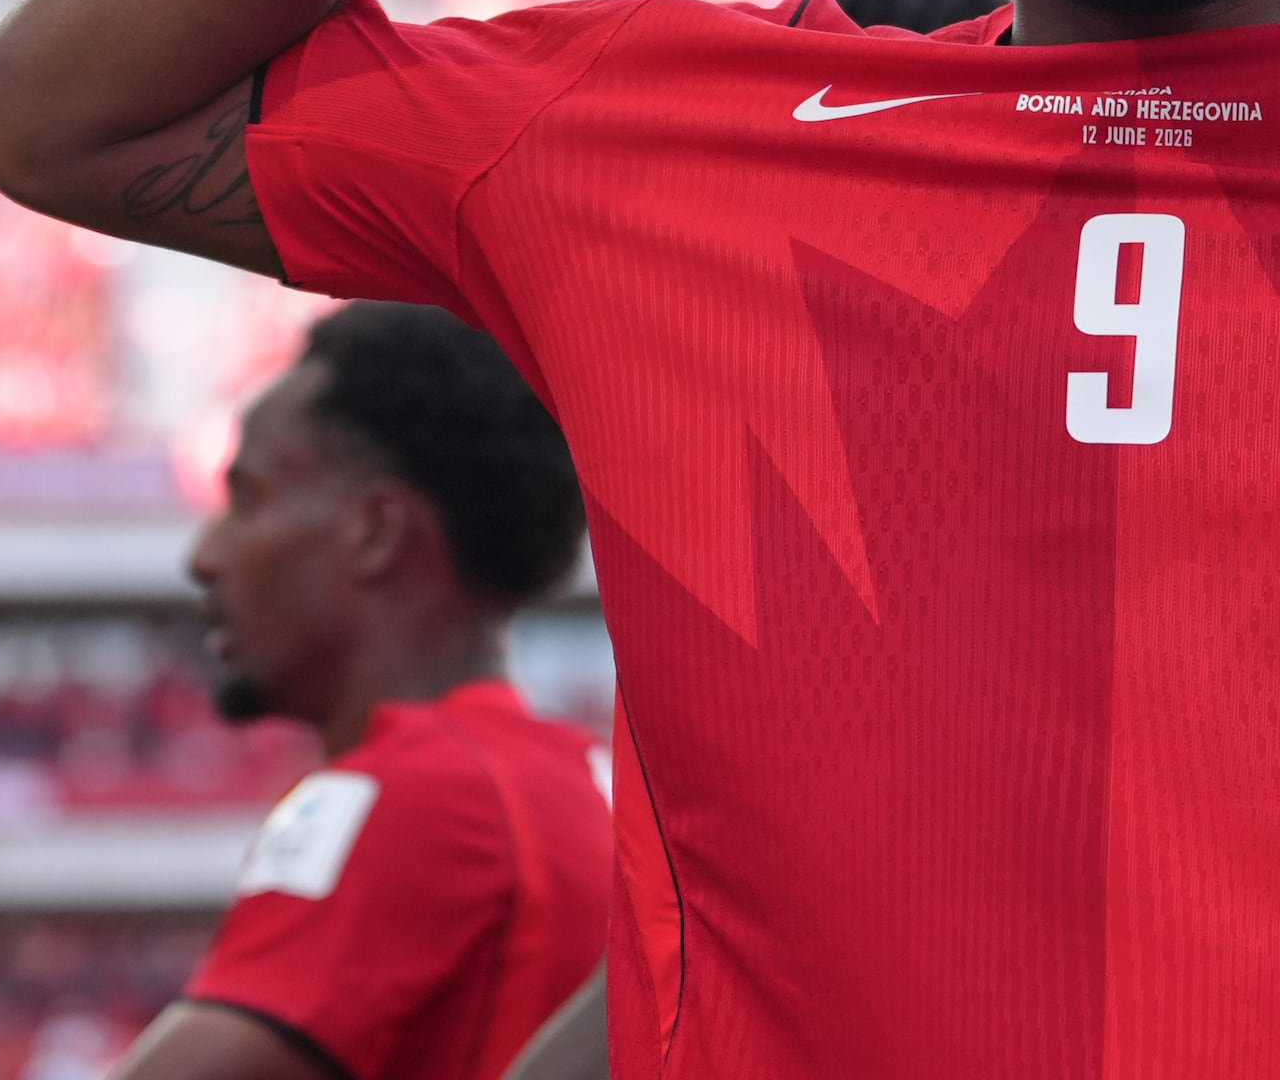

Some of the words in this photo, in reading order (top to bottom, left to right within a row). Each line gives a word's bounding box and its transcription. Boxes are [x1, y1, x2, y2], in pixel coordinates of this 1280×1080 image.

[1015, 93, 1084, 115] BOSNIA
[1091, 97, 1129, 118] AND
[1136, 100, 1263, 121] HERZEGOVINA
[1082, 125, 1097, 145] 12
[1105, 127, 1146, 146] JUNE
[1155, 128, 1193, 147] 2026
[1065, 213, 1186, 445] 9
